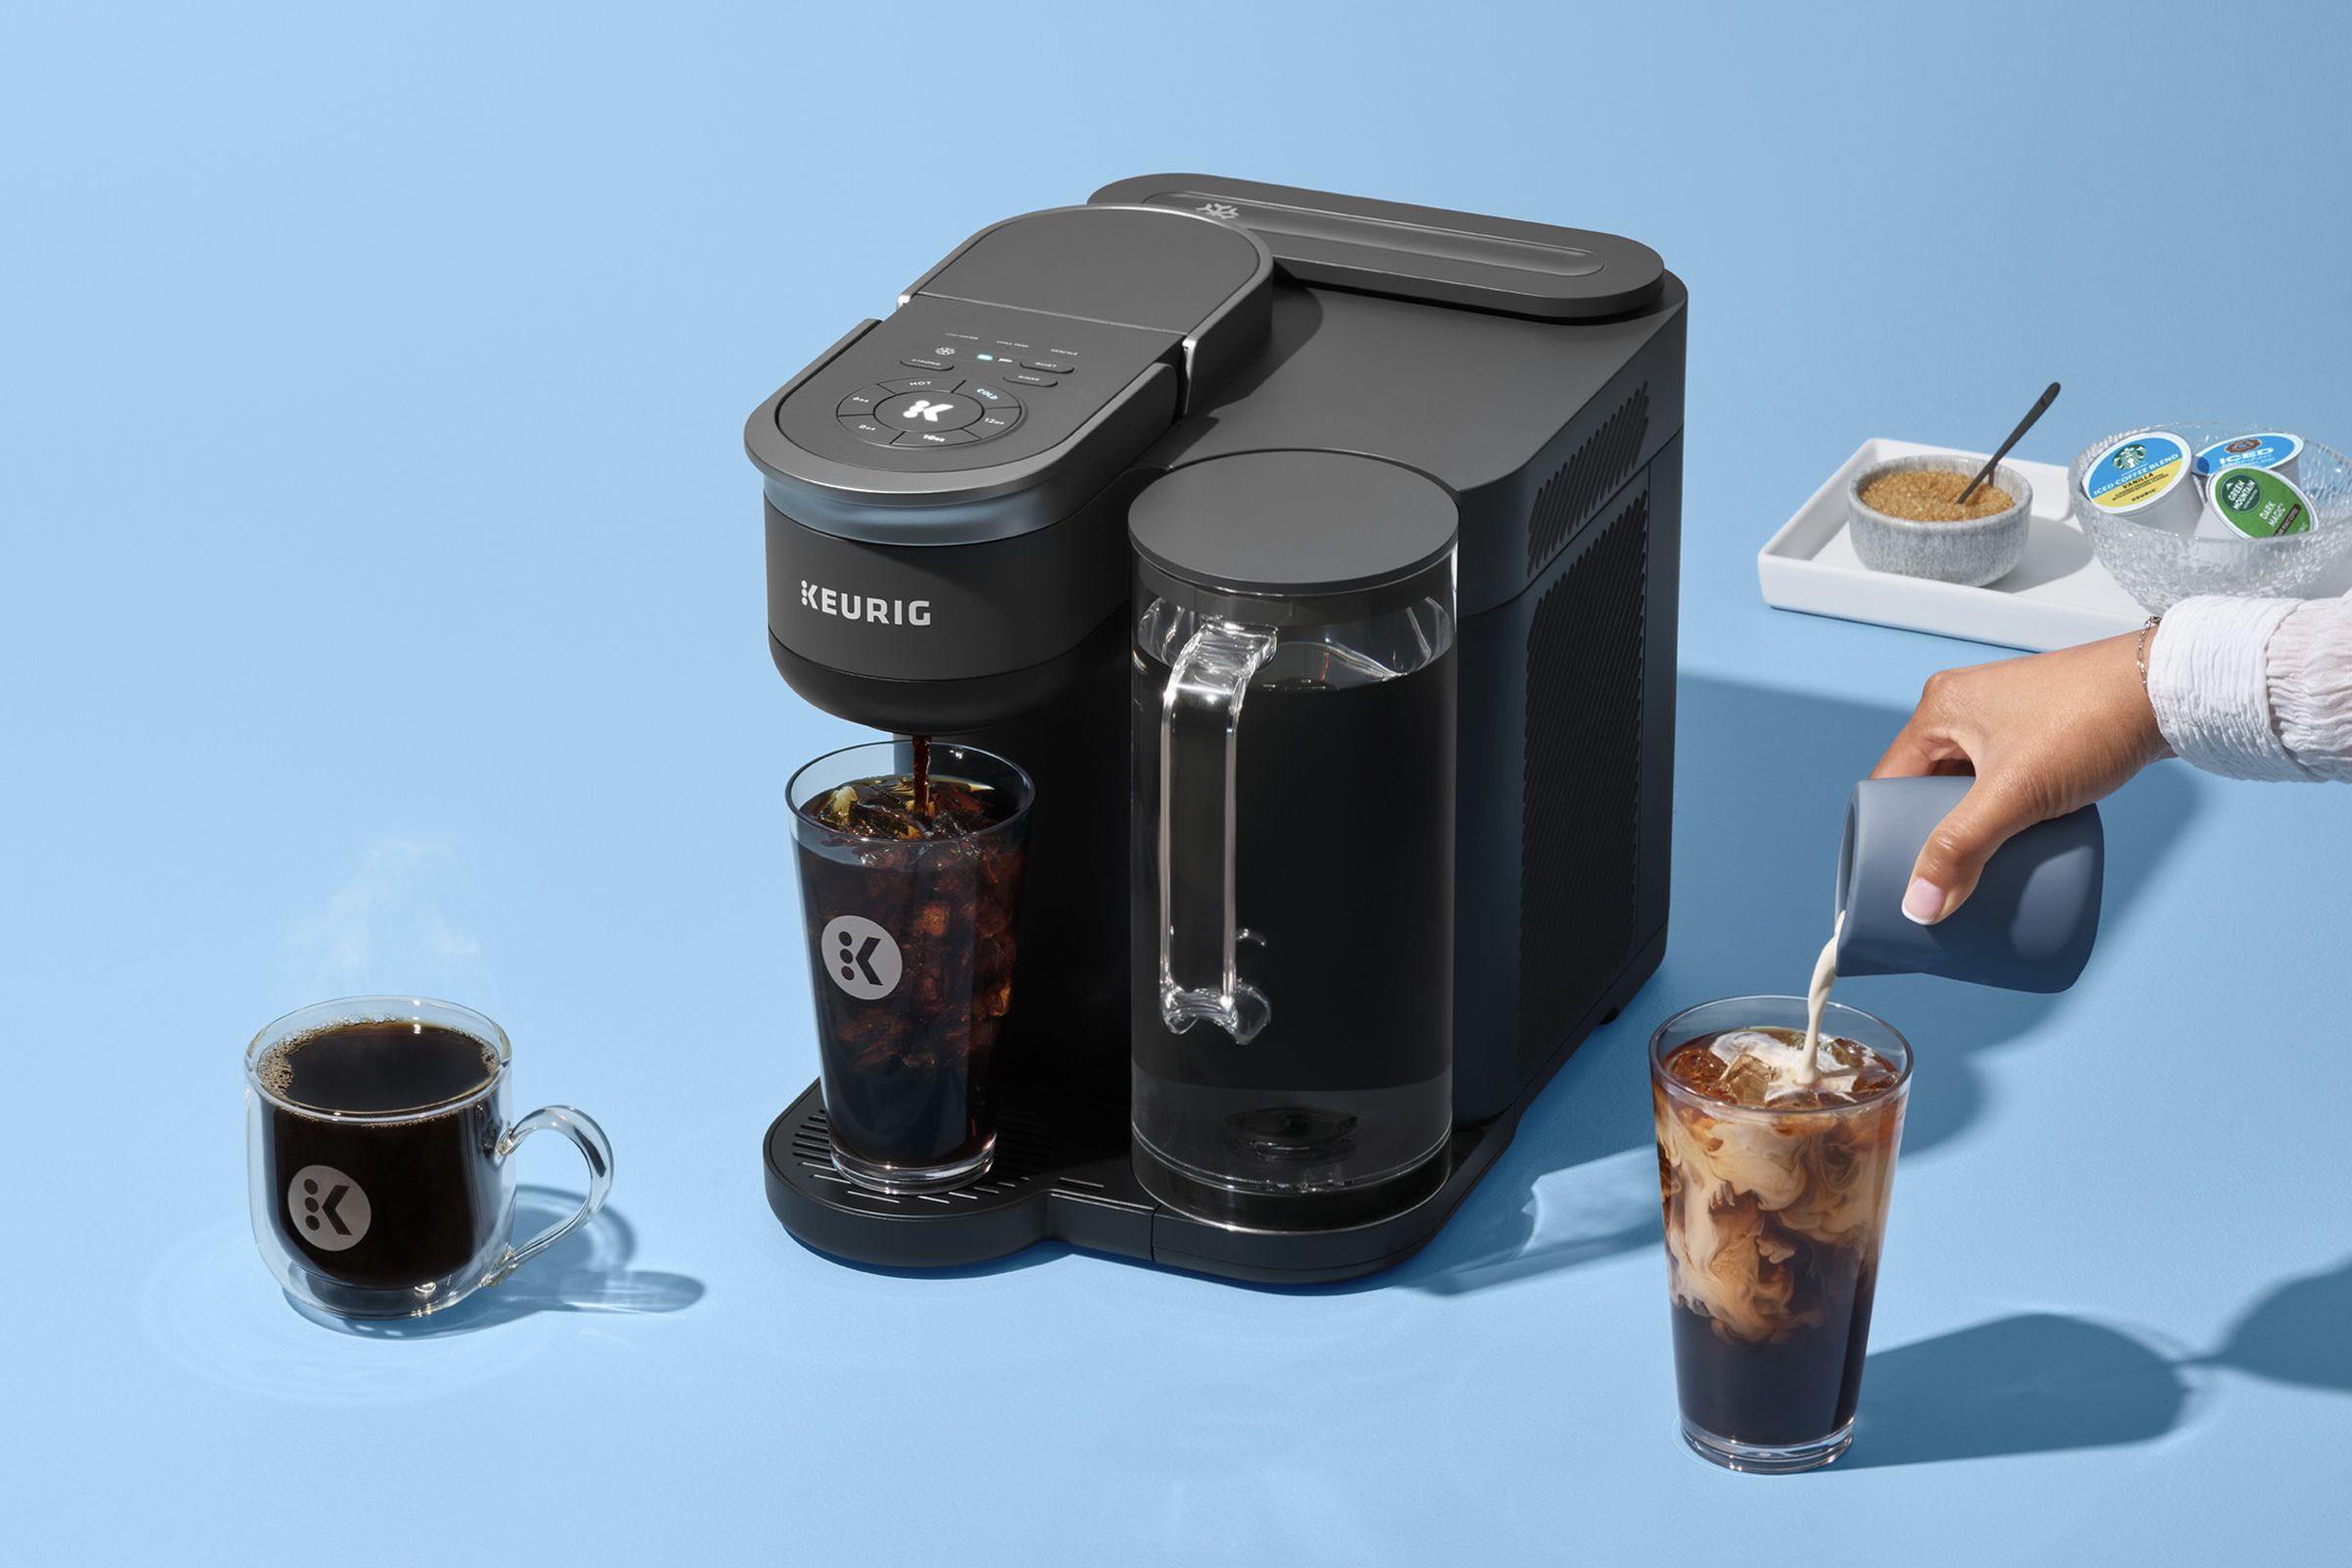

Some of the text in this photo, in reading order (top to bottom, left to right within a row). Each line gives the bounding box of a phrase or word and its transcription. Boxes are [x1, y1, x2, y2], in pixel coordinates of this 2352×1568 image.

[976, 388, 999, 400] COLD
[2219, 447, 2276, 466] ICED
[2092, 482, 2115, 497] ICED
[2115, 465, 2150, 485] COFFEE
[2149, 454, 2180, 469] BLEND
[2122, 471, 2155, 490] VANILLA
[2228, 479, 2245, 502] GREEN
[2231, 478, 2256, 511] MOUNTAIN
[2258, 500, 2277, 520] DARK
[800, 579, 932, 626] KEURIG
